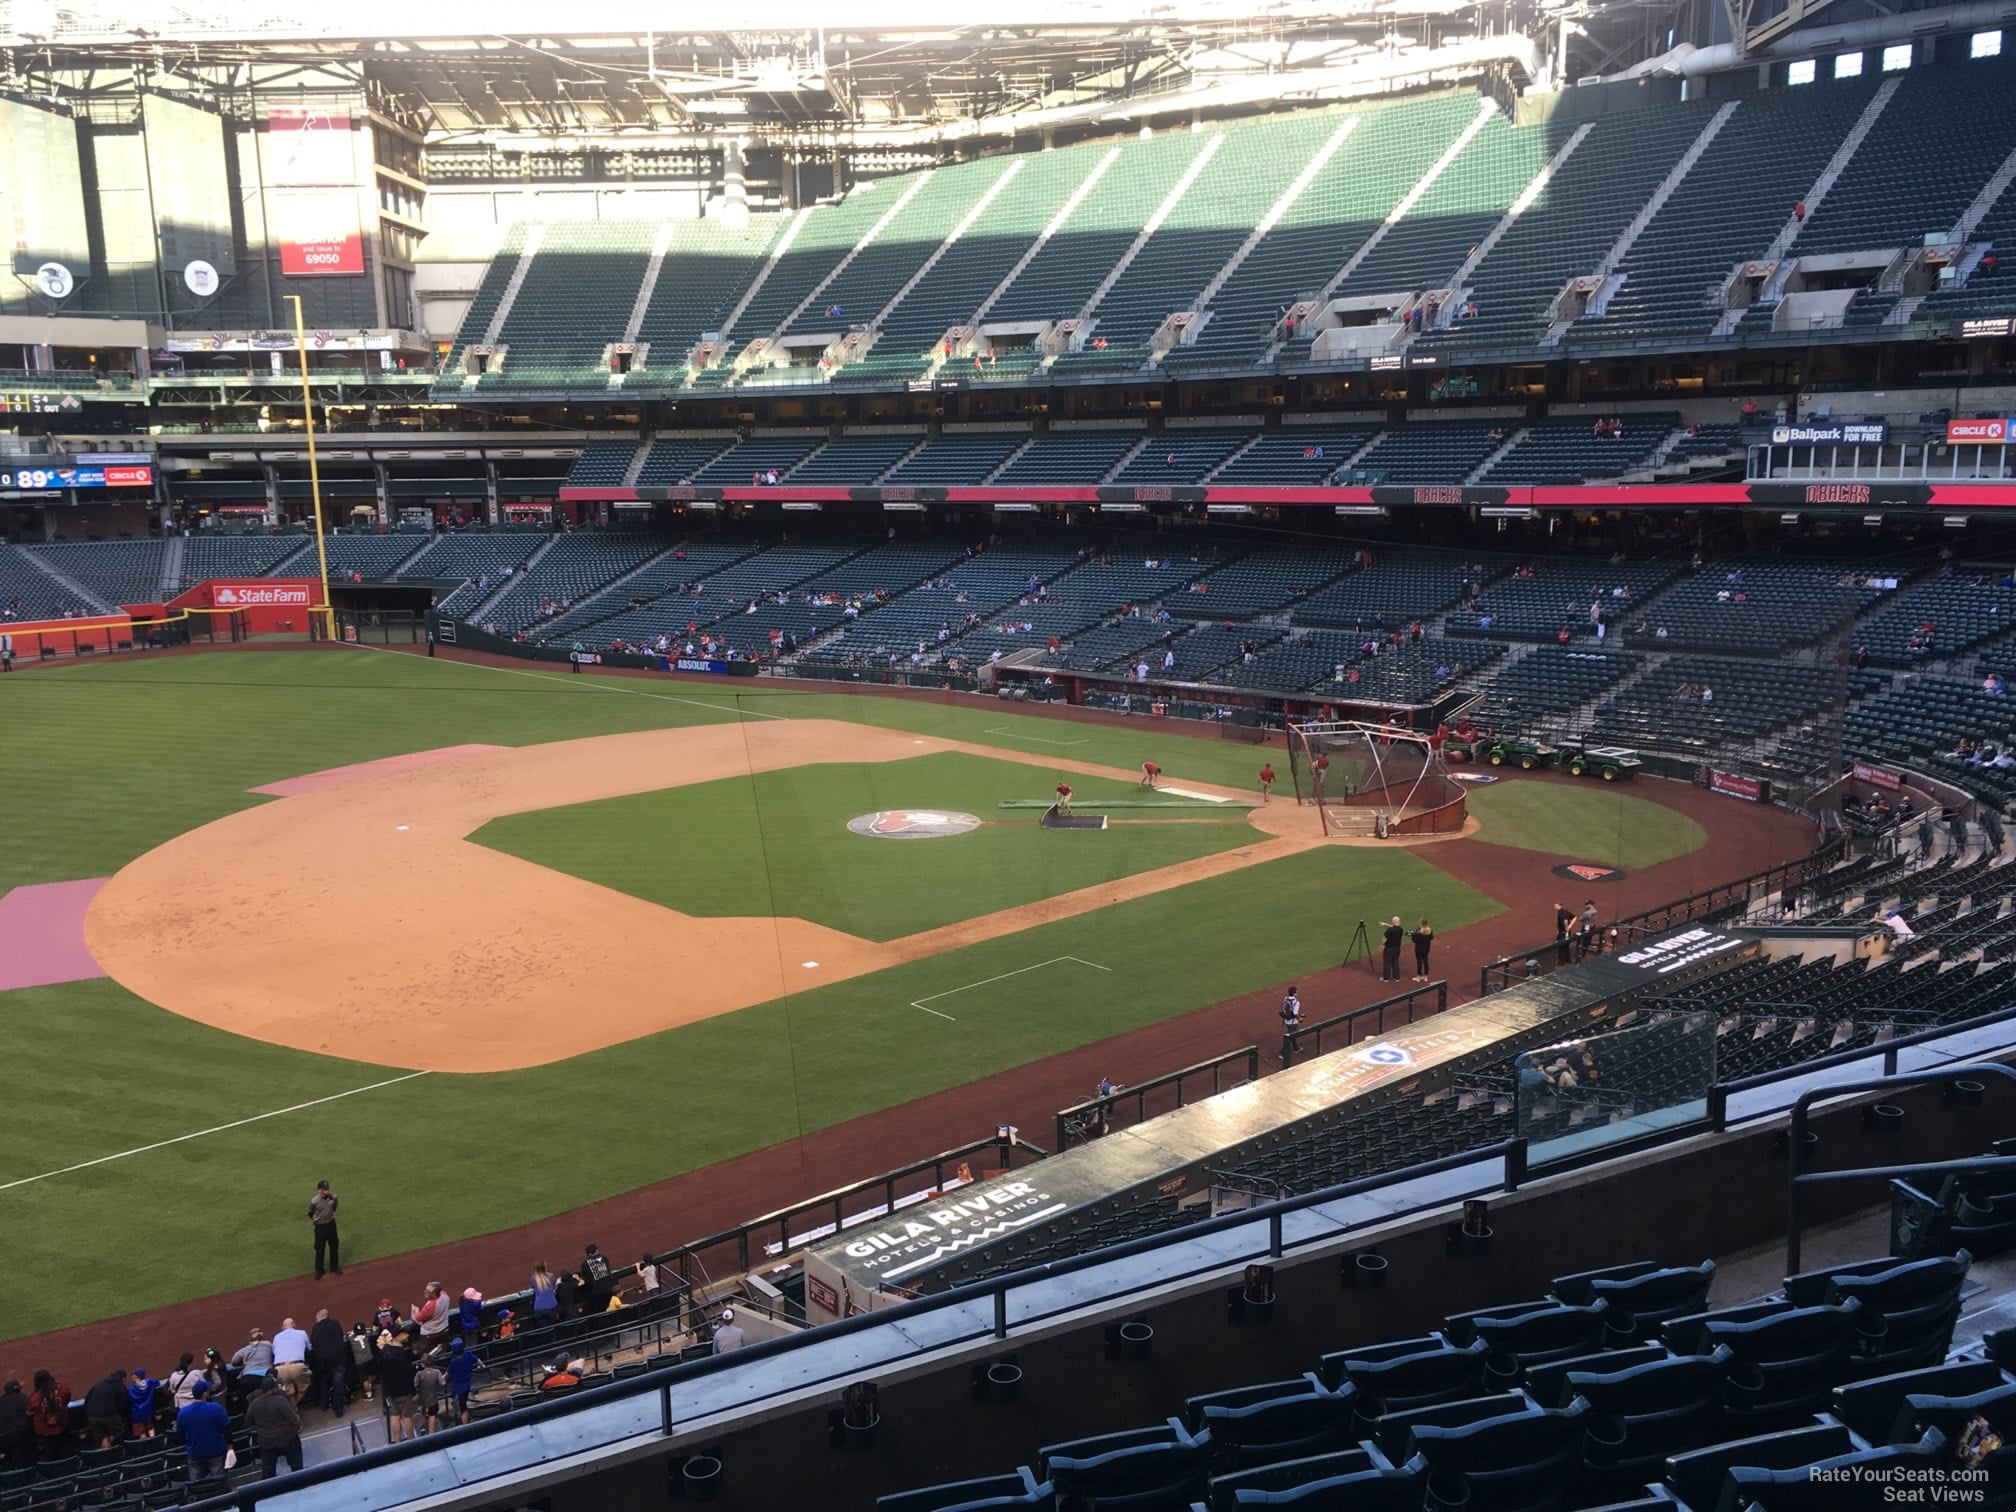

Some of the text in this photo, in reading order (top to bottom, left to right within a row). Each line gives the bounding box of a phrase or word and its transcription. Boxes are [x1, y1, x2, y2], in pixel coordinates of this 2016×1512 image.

[305, 253, 340, 264] 69050
[1790, 428, 1841, 442] Ballpark
[1844, 425, 1883, 433] DOWNLOAD
[1952, 426, 1986, 435] CIRCLE
[1843, 433, 1882, 442] FOR FREE
[1618, 928, 1713, 964] GILA RIVER
[1408, 1034, 1460, 1051] FIELD
[845, 1181, 1037, 1257] GILA RIVER
[863, 1193, 1050, 1269] HOTELS & CASINOS
